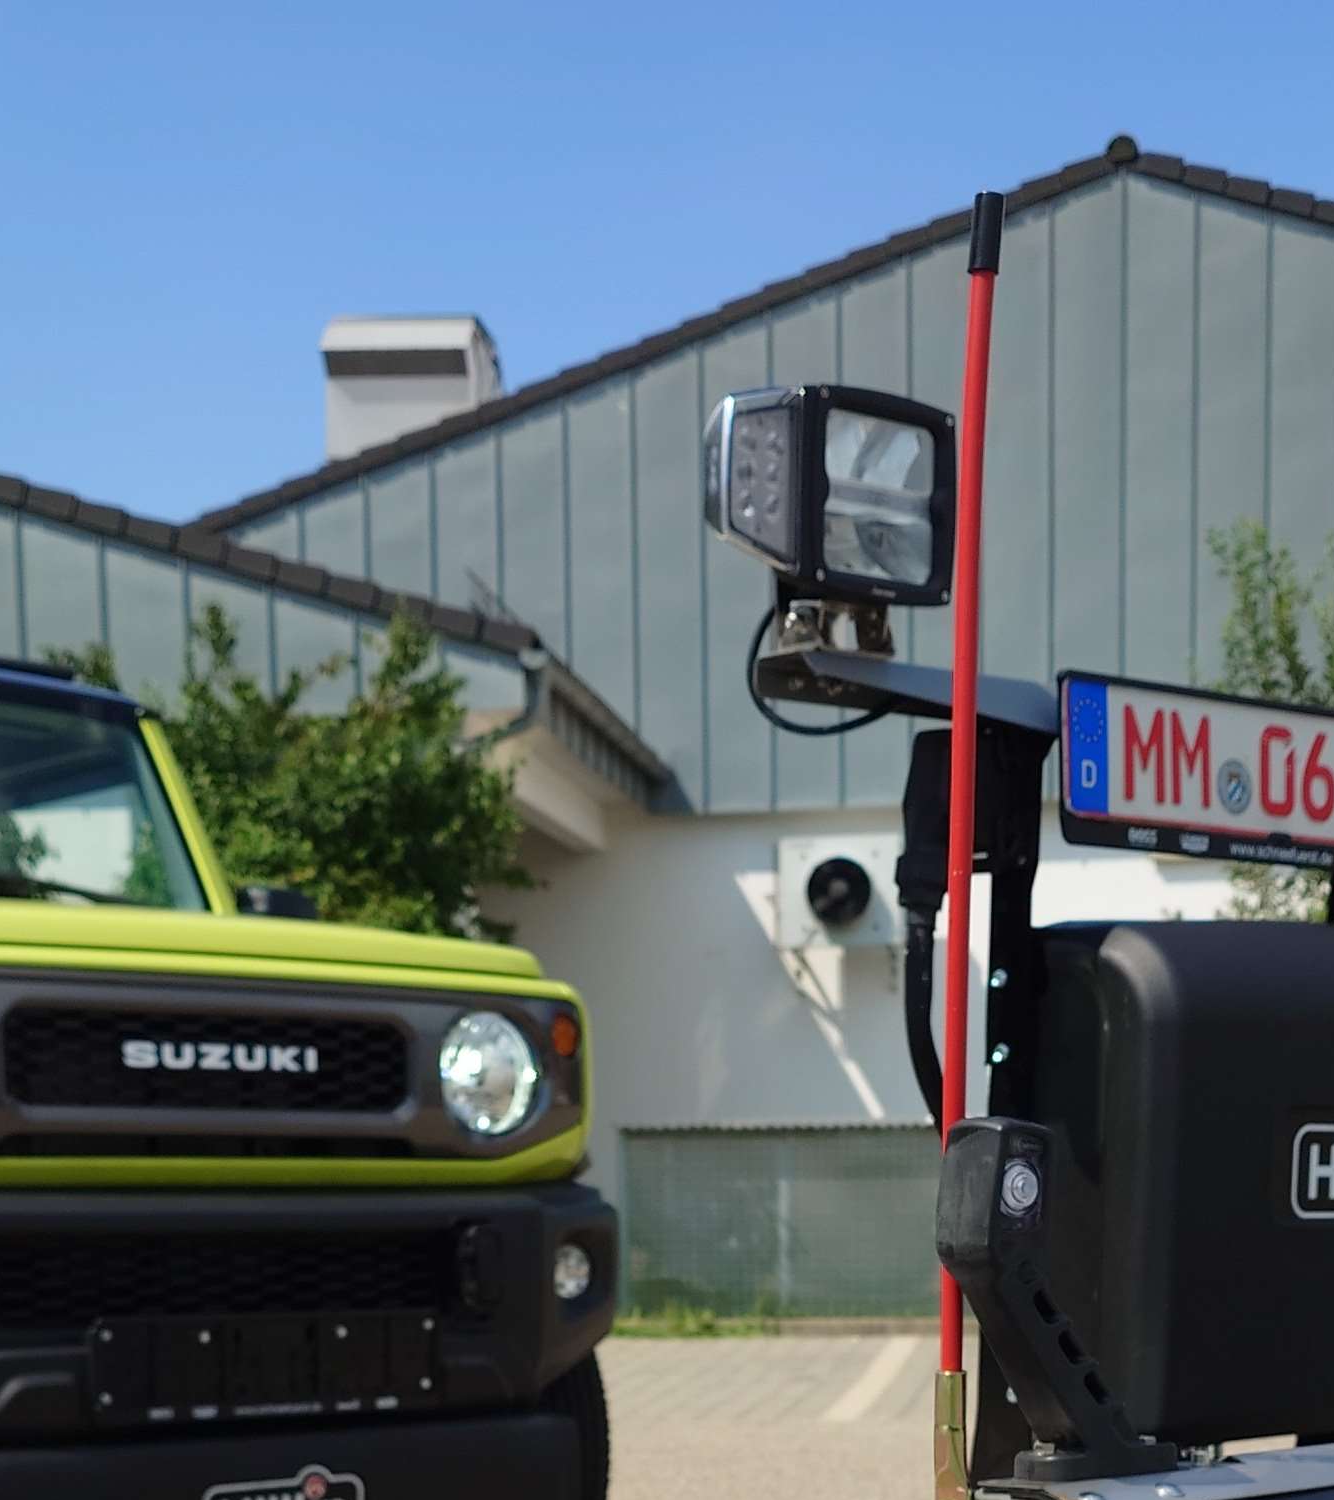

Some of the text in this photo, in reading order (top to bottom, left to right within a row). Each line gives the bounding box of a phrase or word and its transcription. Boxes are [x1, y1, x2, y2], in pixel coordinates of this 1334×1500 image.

[1081, 758, 1098, 789] D
[1123, 703, 1211, 810] MM
[121, 1039, 319, 1073] SUZUKI
